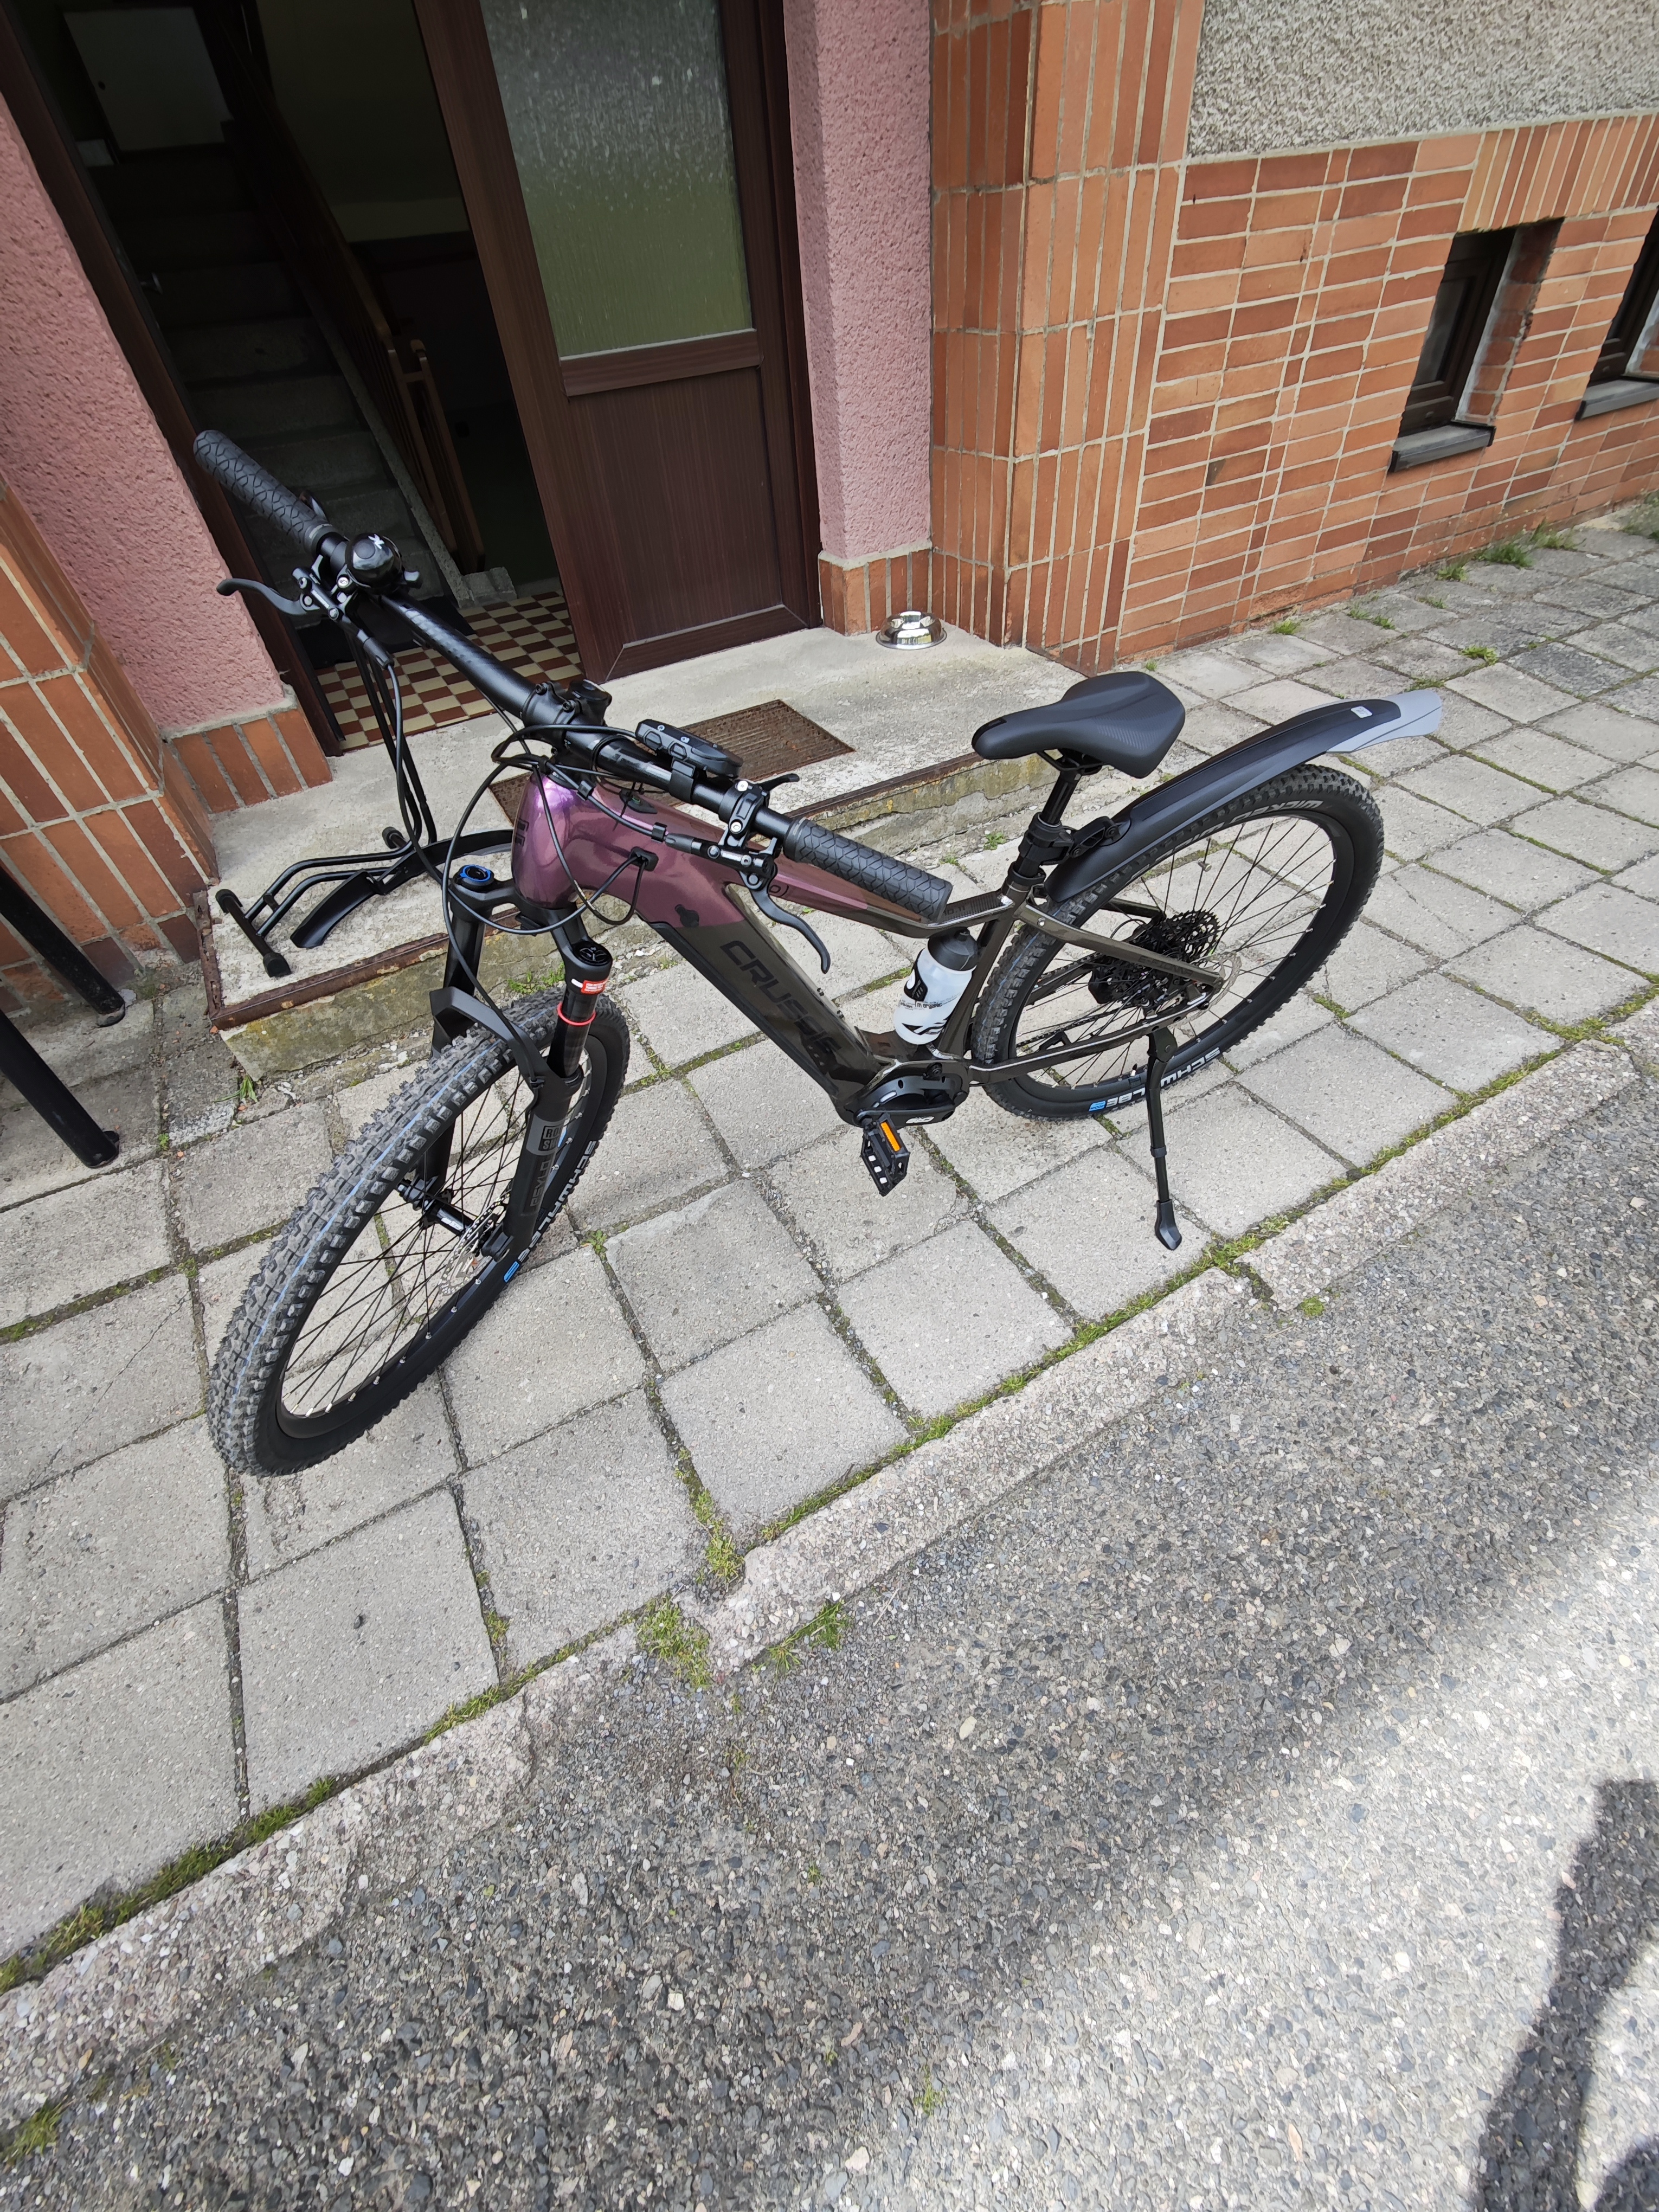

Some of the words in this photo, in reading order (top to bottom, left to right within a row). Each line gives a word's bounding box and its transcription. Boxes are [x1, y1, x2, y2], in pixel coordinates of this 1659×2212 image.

[1229, 800, 1324, 825] WICKED
[719, 940, 841, 1053] CRUSSIS
[1105, 1047, 1220, 1108] SCHWLBE
[517, 1140, 597, 1263] SCHWALBE
